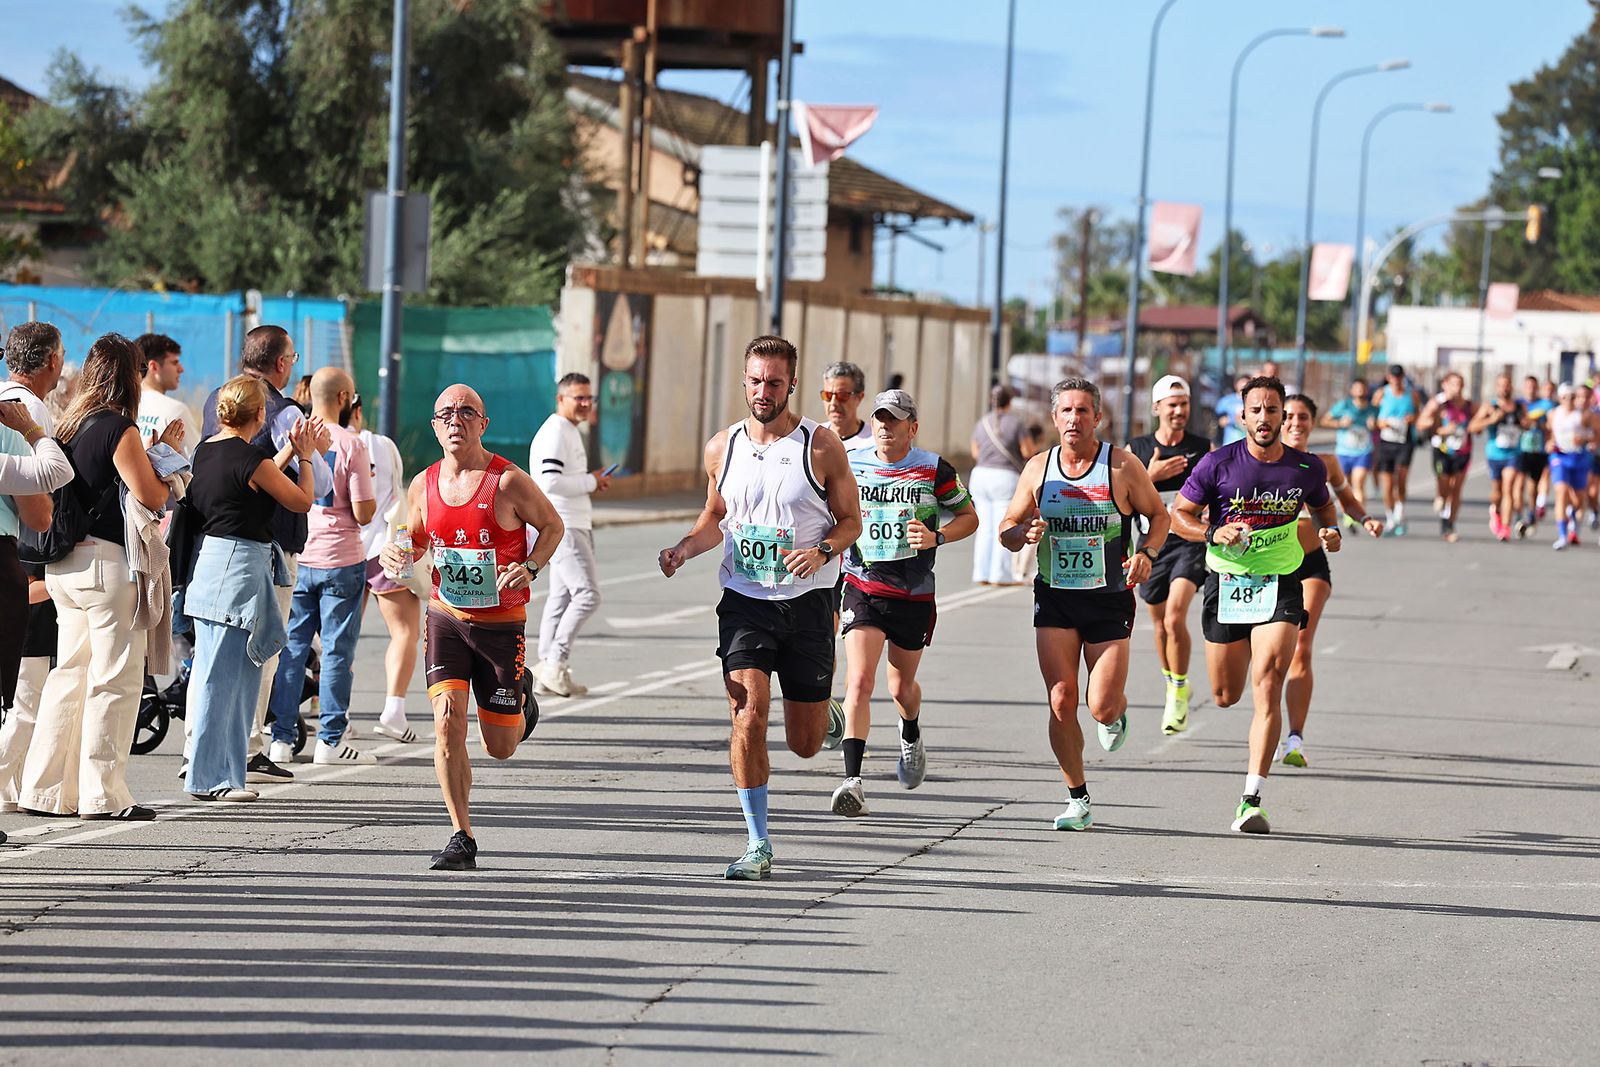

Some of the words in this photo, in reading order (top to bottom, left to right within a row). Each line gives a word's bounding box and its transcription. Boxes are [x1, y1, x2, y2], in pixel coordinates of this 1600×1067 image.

[776, 529, 790, 538] 2K
[870, 523, 904, 540] 603
[477, 552, 490, 561] 2K
[740, 539, 778, 561] 601
[1058, 552, 1093, 568] 578
[444, 565, 484, 585] 343
[1230, 587, 1263, 603] 481
